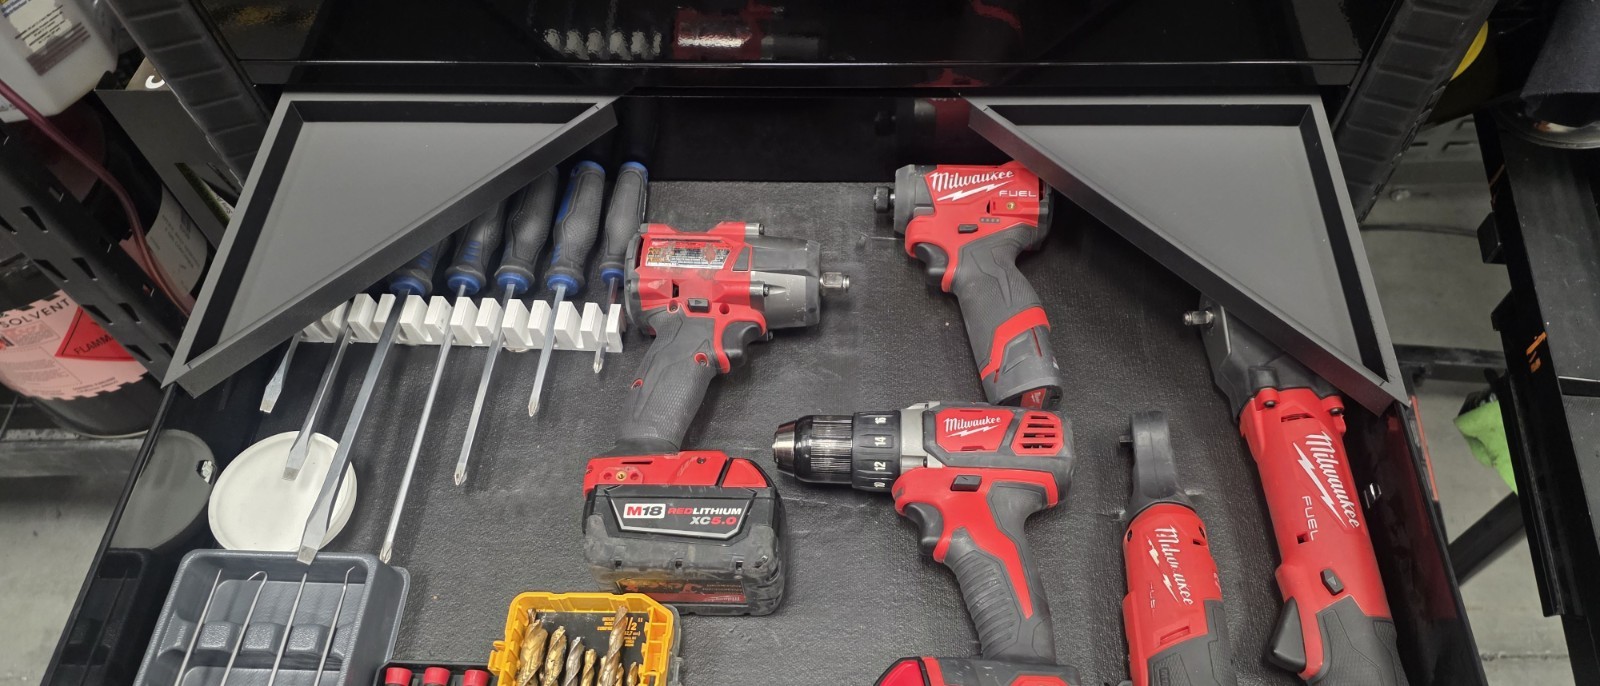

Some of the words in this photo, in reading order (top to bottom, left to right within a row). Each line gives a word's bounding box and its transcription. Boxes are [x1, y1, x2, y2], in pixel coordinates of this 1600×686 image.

[929, 169, 1014, 193] Milwaukee
[0, 299, 70, 328] SOLVENT
[74, 334, 113, 355] FLAMM
[943, 416, 1001, 433] Milwaukee
[875, 436, 886, 446] 14
[874, 461, 886, 471] 12
[1305, 430, 1360, 528] Milwaukee
[626, 506, 663, 516] M18
[690, 516, 737, 525] XC5.0
[1302, 495, 1319, 541] FUEL
[1154, 524, 1194, 606] Milwukee
